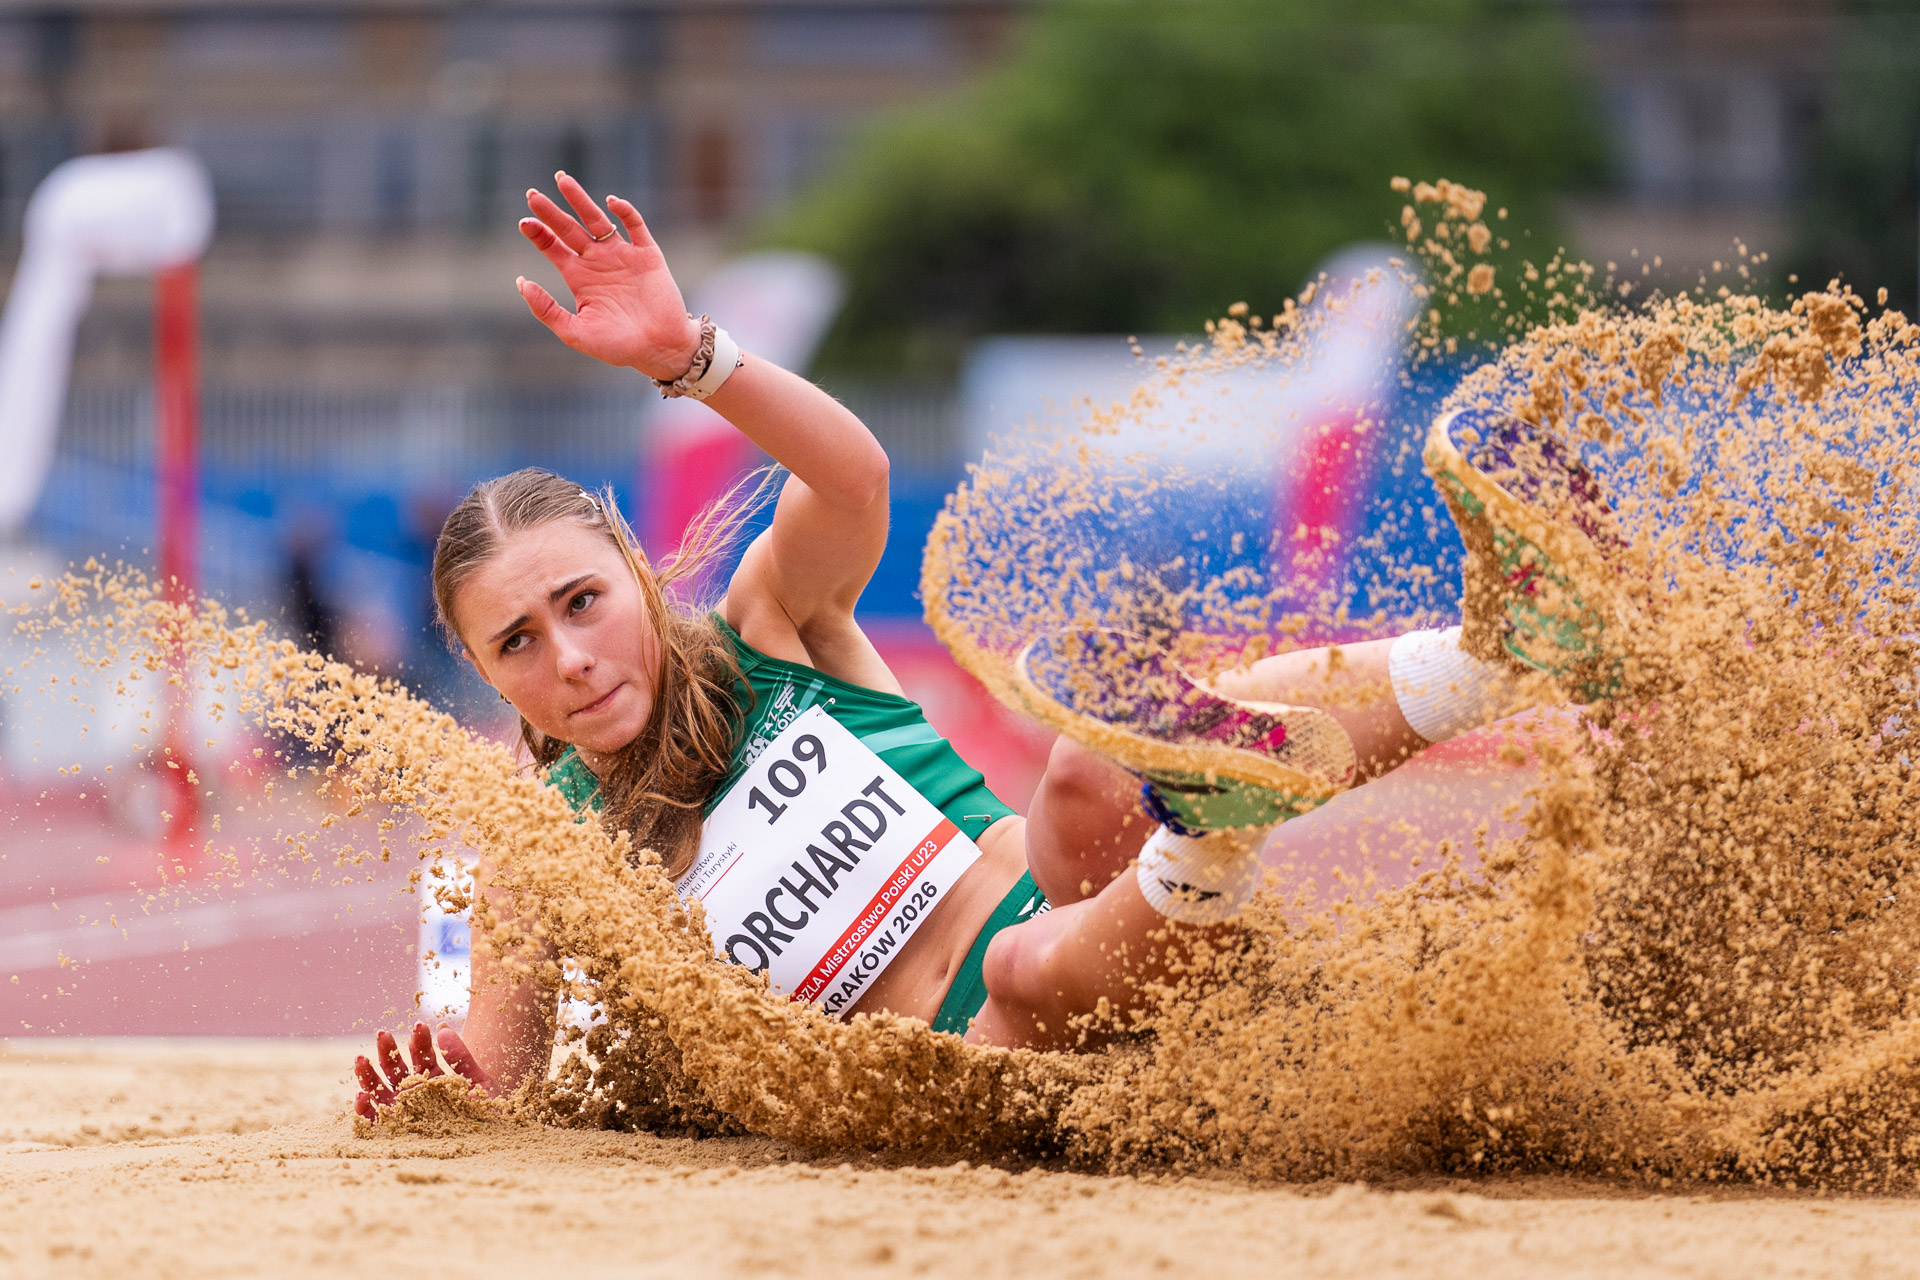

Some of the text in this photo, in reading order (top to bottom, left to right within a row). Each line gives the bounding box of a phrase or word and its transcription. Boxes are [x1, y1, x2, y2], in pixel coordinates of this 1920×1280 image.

[748, 733, 827, 826] 109
[674, 851, 715, 896] inisterstwo
[703, 841, 738, 880] Turystyki
[716, 775, 906, 977] ORCHARDT
[796, 840, 938, 1003] PZLA Mistrzostwa Polski U23
[821, 881, 938, 1016] KRAKÓW 2026
